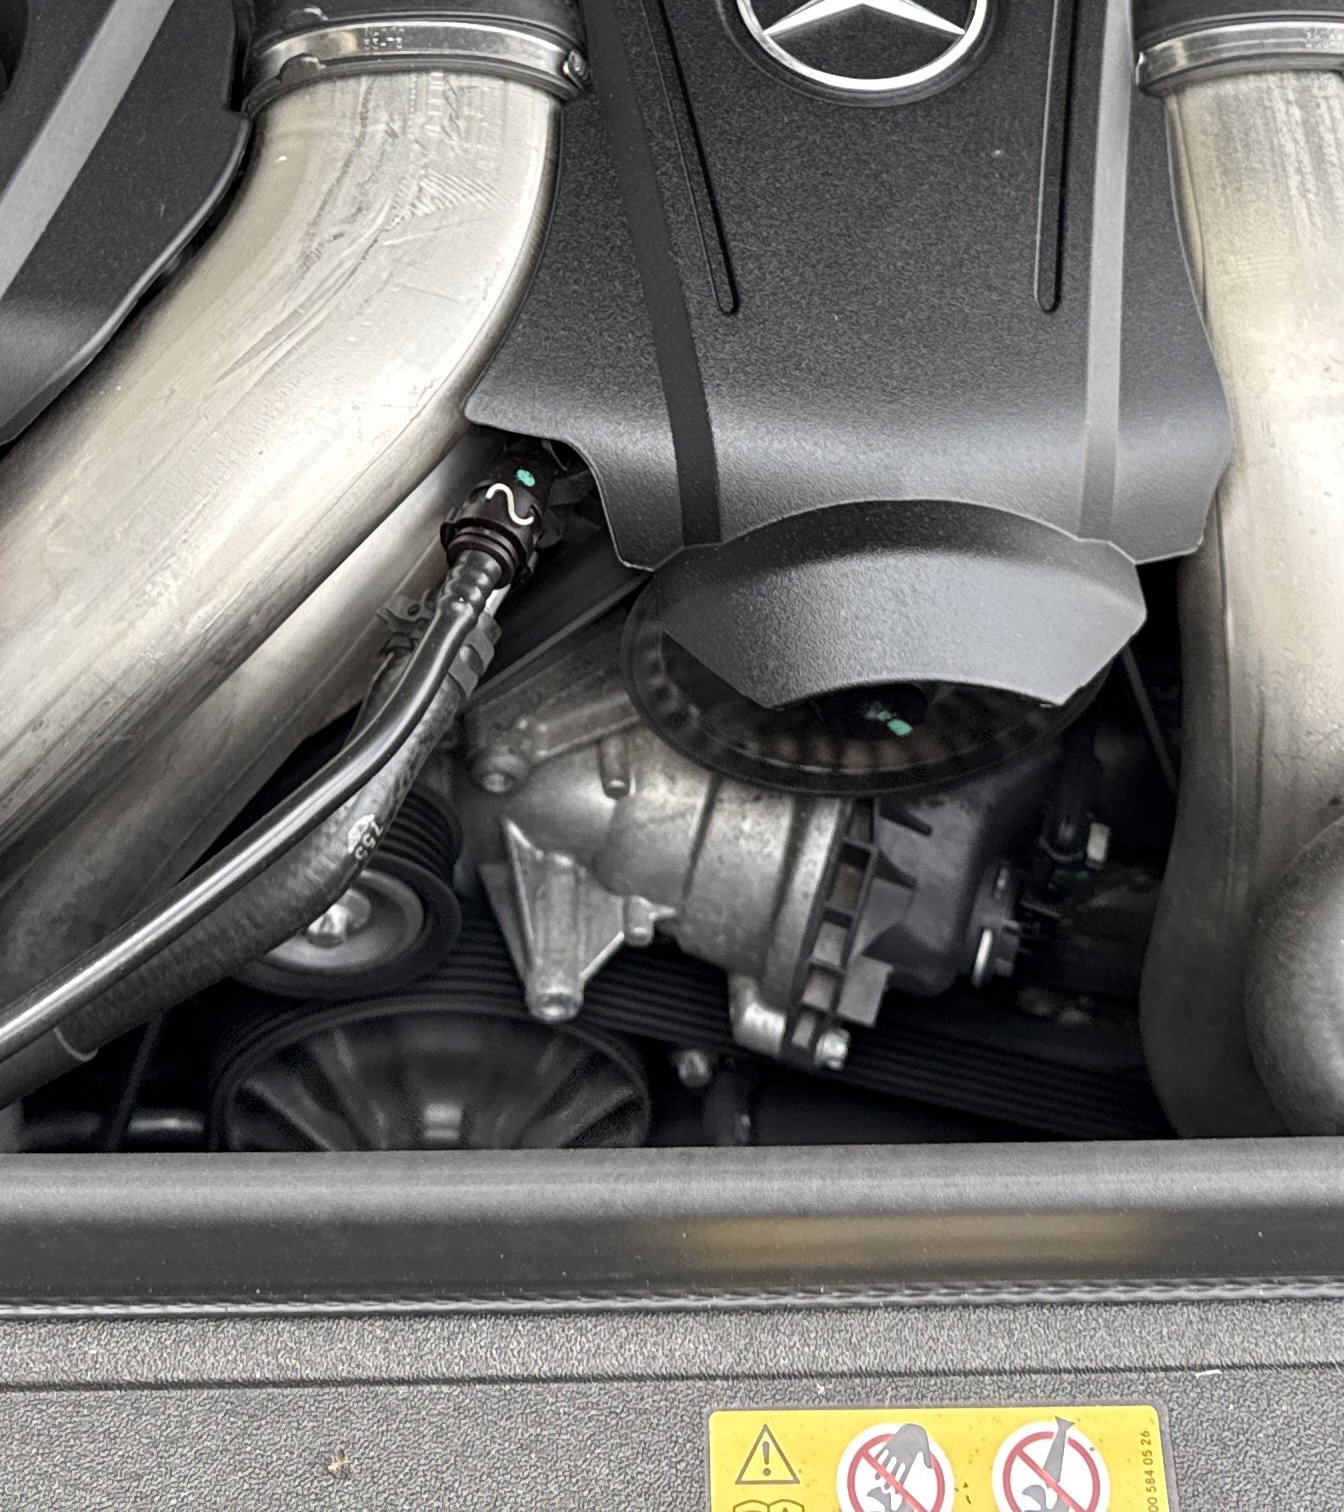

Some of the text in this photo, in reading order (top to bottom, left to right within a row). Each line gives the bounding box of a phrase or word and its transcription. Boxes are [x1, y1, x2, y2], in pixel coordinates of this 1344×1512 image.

[1140, 1430, 1152, 1446] 26
[1141, 1450, 1154, 1466] 05
[1144, 1469, 1157, 1493] 584
